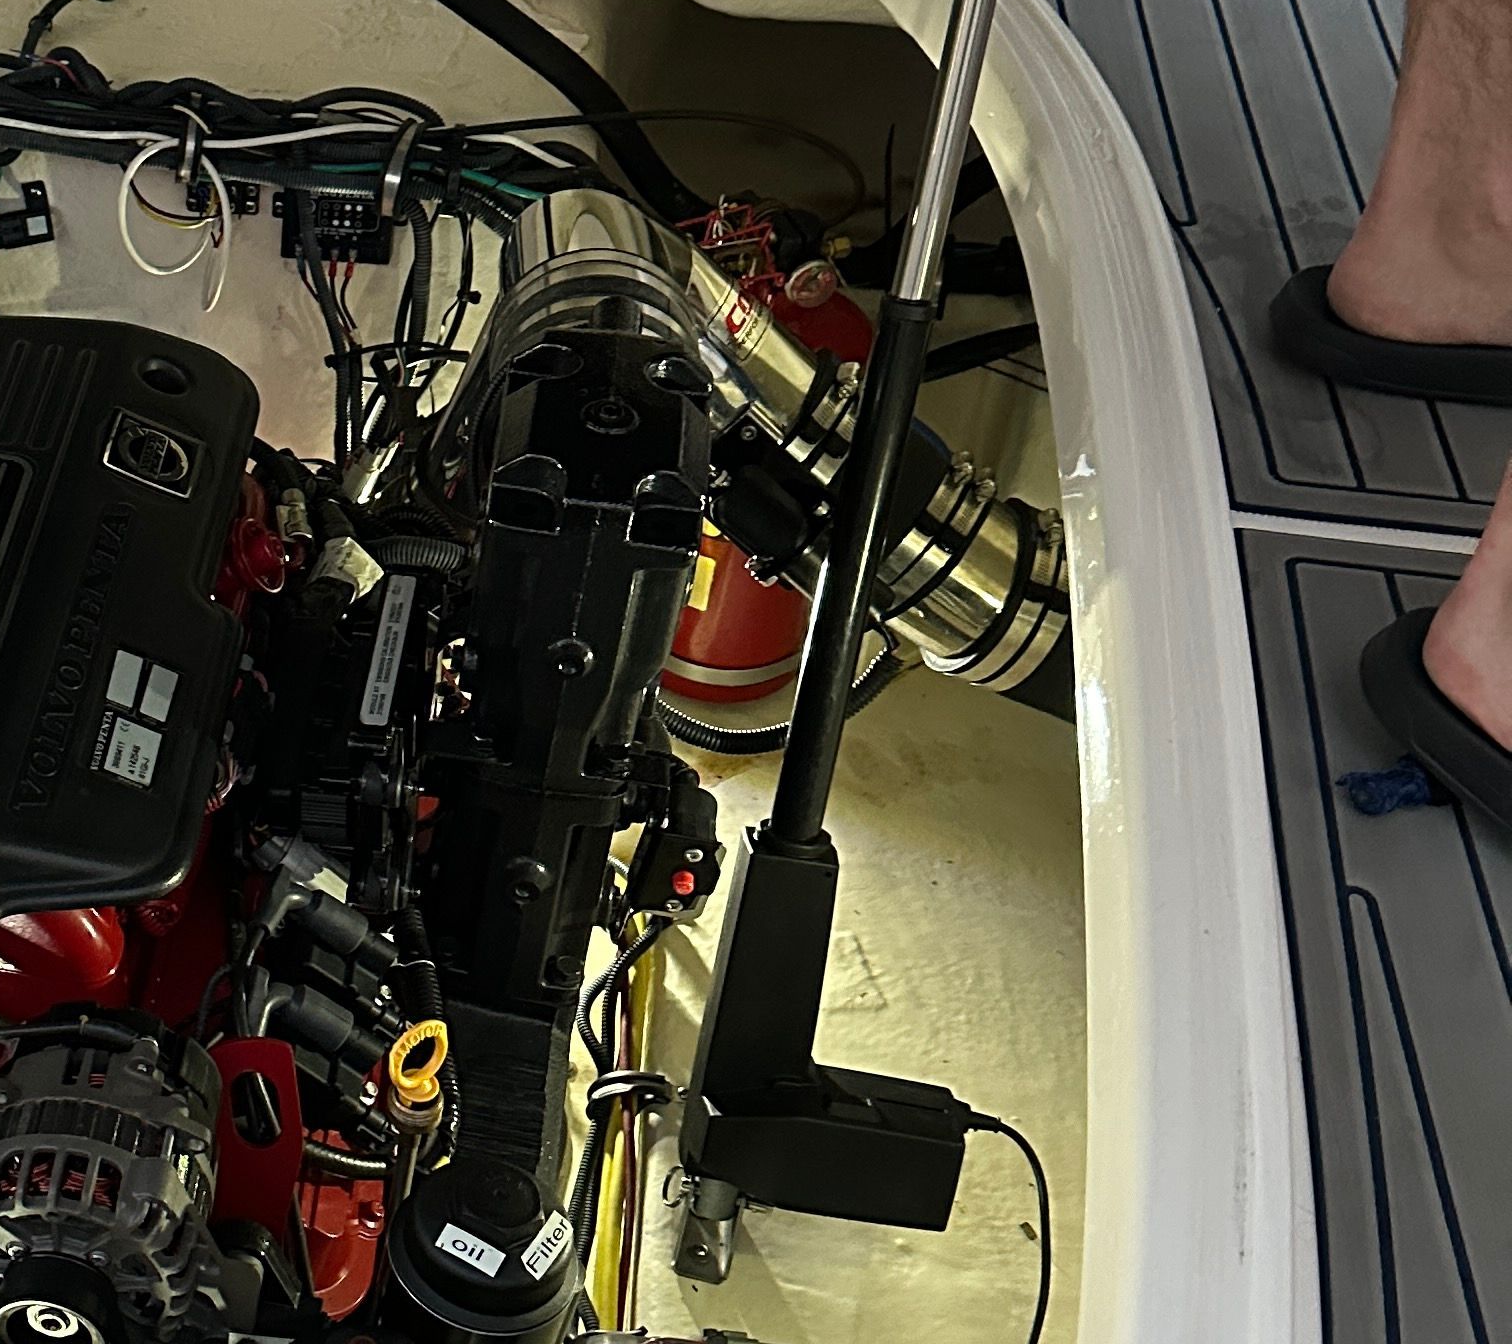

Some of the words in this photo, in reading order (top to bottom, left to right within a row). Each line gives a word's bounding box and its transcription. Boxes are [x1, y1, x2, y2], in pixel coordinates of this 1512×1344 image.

[11, 658, 88, 808] VOLVO
[60, 506, 133, 658] PENTA
[91, 744, 105, 770] VOLVO
[98, 711, 114, 742] PENTA
[451, 1239, 485, 1262] oil
[525, 1218, 568, 1274] Filter
